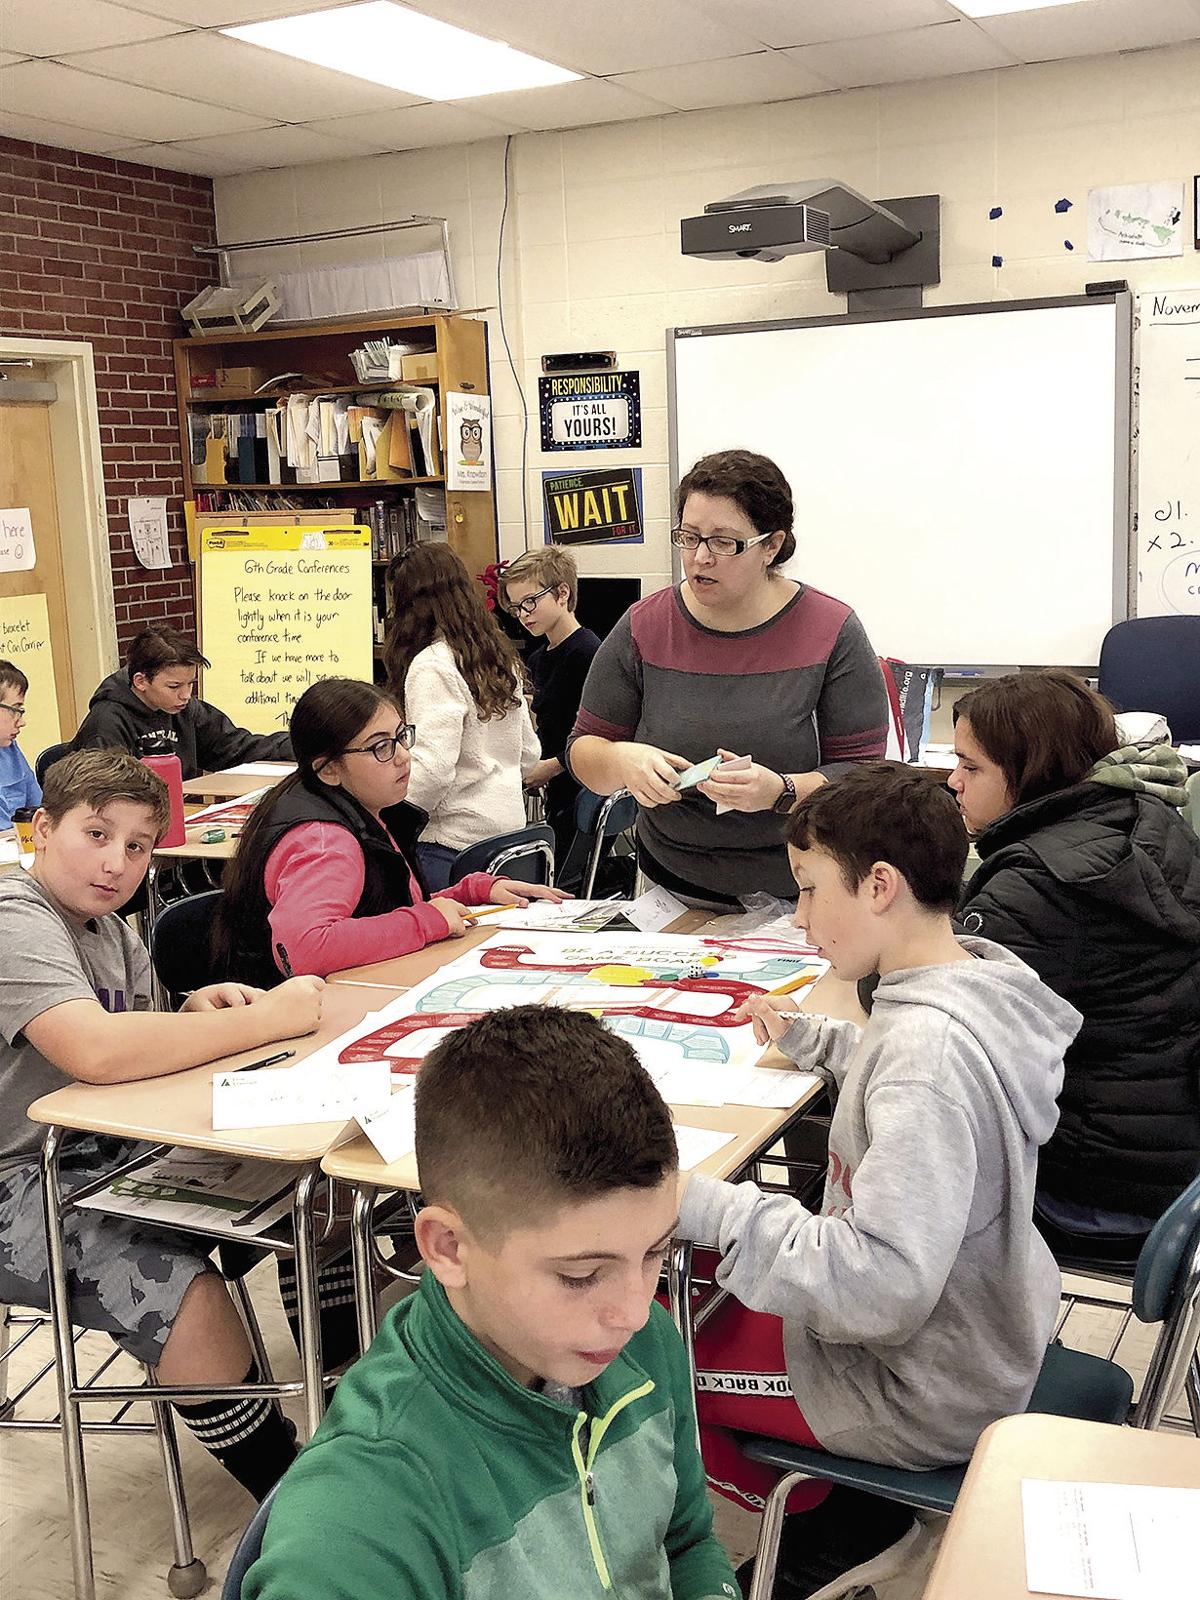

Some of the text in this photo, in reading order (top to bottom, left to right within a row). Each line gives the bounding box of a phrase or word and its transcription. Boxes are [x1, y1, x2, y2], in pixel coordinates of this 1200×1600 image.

[729, 224, 752, 234] SMART
[552, 374, 623, 396] RESPONSIBILITY
[573, 404, 606, 416] IT'S ALL
[565, 417, 616, 437] YOURS!
[554, 485, 629, 531] WAIT
[2, 520, 25, 538] here
[612, 525, 626, 537] FOR
[244, 559, 350, 575] 6th Grade Conferences
[234, 586, 353, 603] Please knock on the door
[237, 608, 340, 630] lightly when it is your
[237, 628, 303, 643] conference time
[254, 649, 340, 664] If we have more to
[240, 669, 255, 683] talk
[256, 670, 278, 683] about
[296, 668, 311, 685] will
[245, 690, 280, 704] additional
[713, 1377, 759, 1390] BACK
